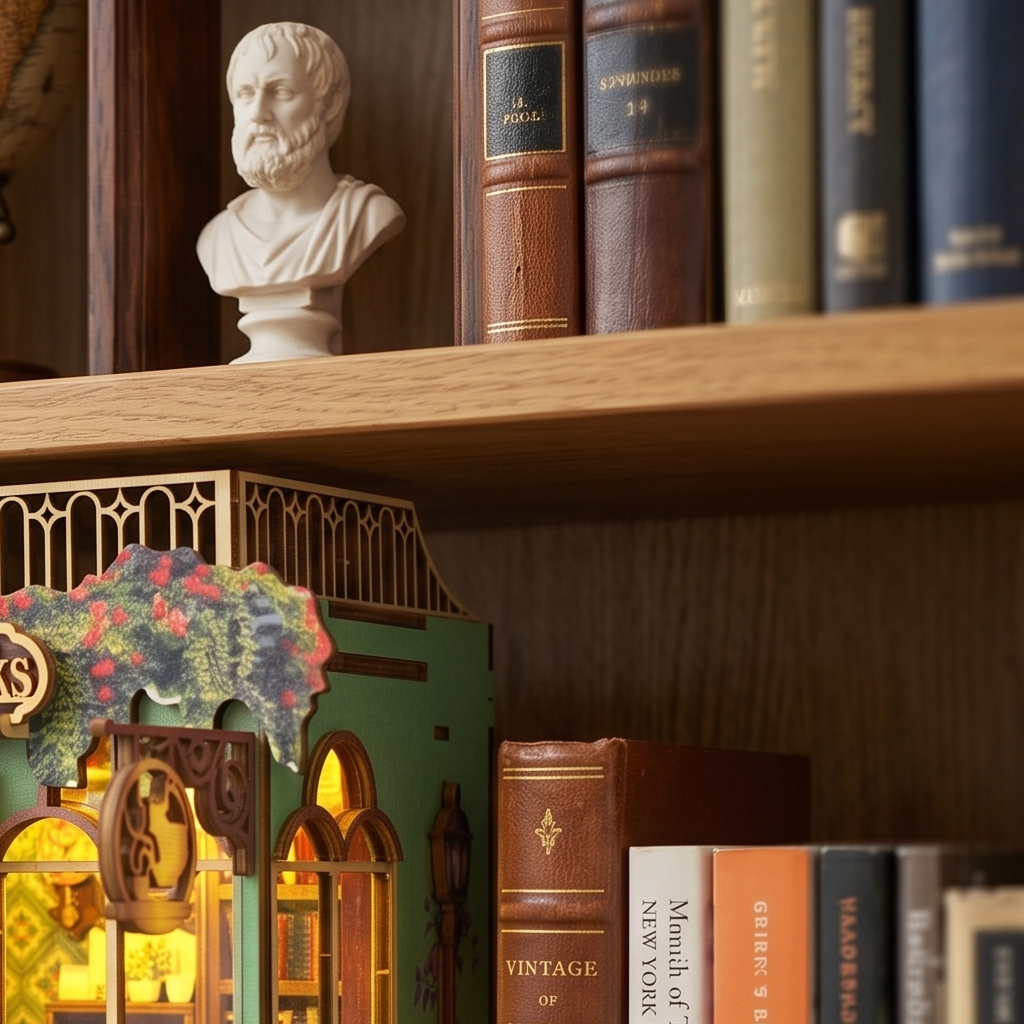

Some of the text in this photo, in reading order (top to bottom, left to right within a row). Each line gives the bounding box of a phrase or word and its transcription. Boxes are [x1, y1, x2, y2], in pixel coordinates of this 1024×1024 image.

[641, 899, 657, 951] NEW
[506, 960, 598, 977] VINTAGE
[641, 957, 657, 1017] YORK
[668, 986, 690, 1010] of
[538, 994, 558, 1006] OF
